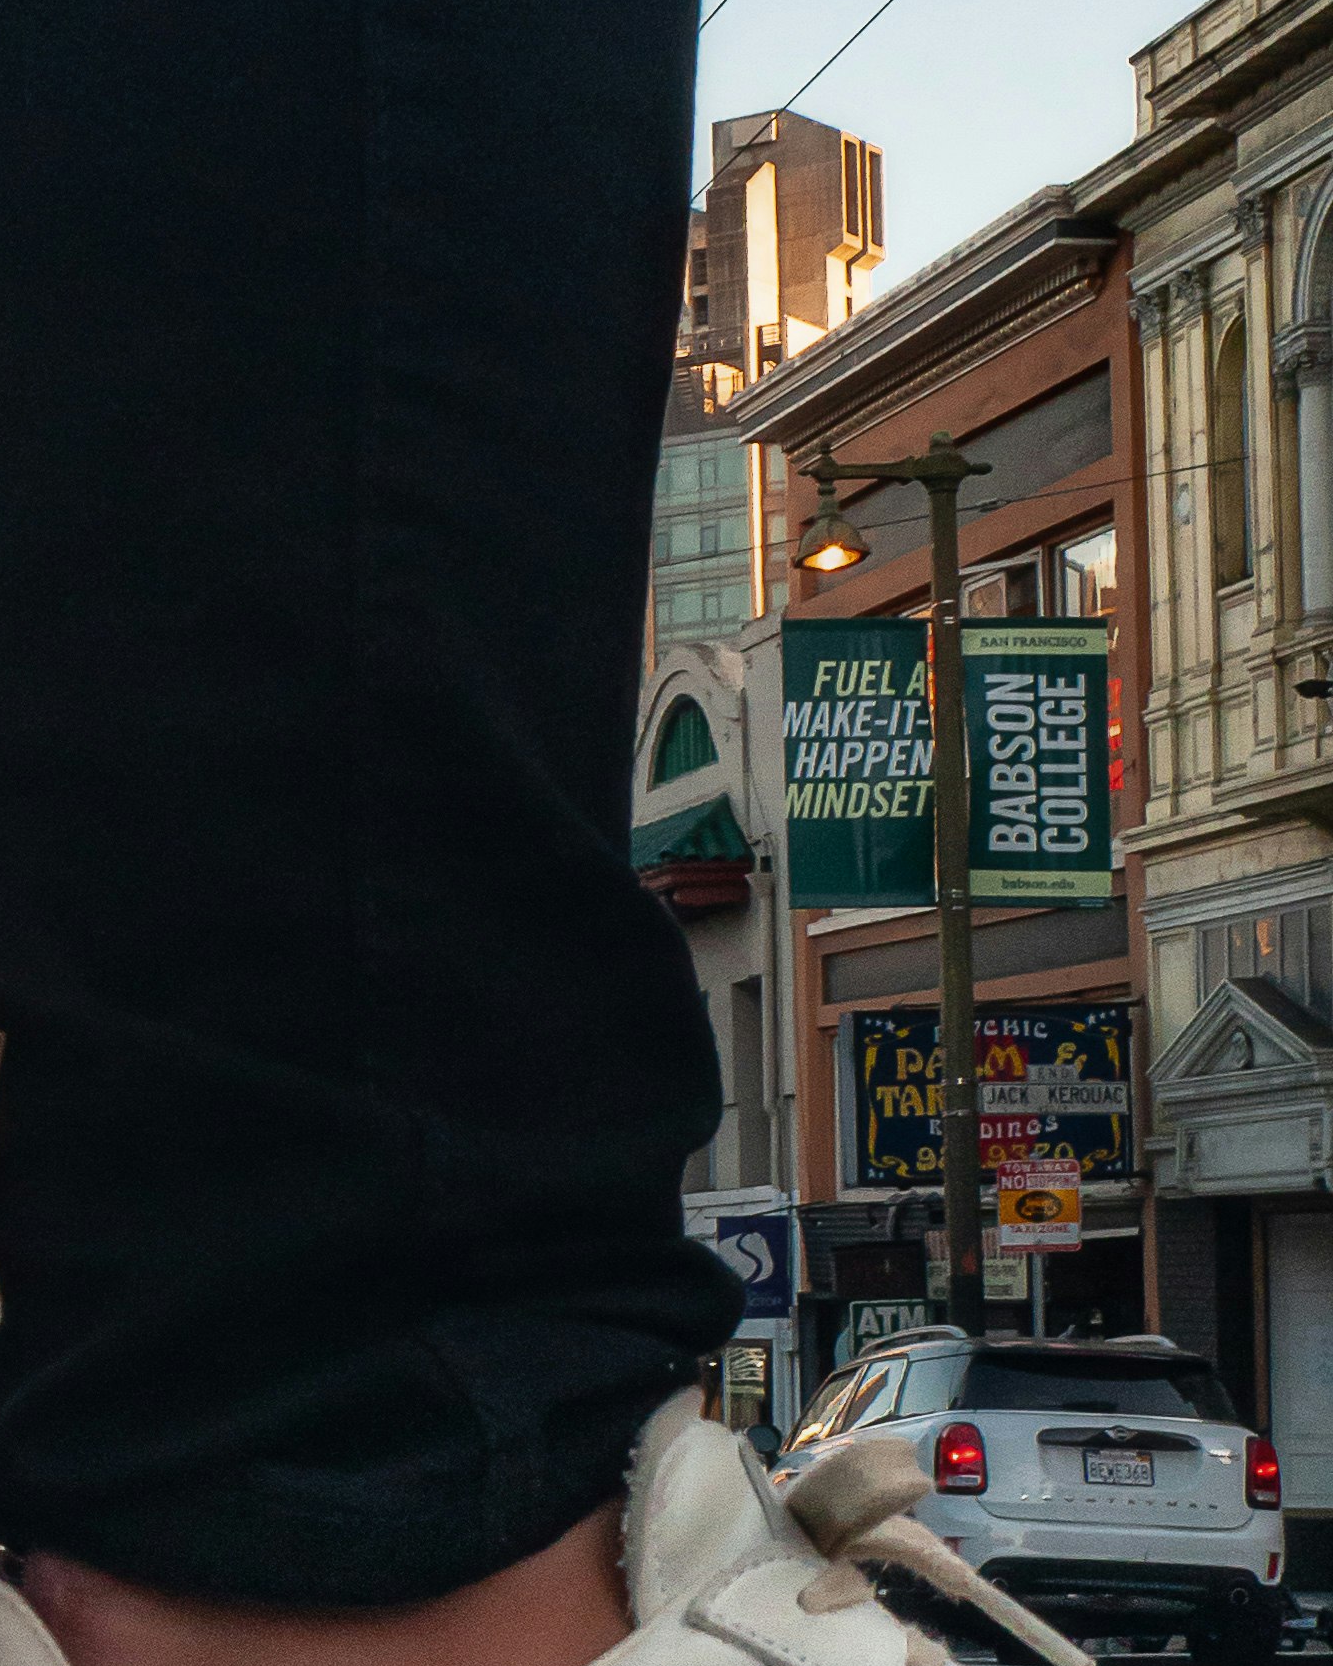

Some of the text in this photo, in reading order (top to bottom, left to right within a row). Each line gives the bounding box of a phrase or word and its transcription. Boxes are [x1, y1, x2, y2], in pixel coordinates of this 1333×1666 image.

[980, 636, 1087, 648] SAN FRANCISCO
[813, 660, 926, 697] FUEL A
[782, 700, 929, 738] MAKE-IT-
[793, 739, 933, 778] HAPPEN
[984, 673, 1037, 853] BABSON
[1037, 673, 1089, 853] COLLEGE
[785, 780, 935, 819] MINDSET
[986, 1085, 1124, 1104] JACK KEROUAC
[1000, 1175, 1025, 1189] NO
[857, 1304, 926, 1335] ATM
